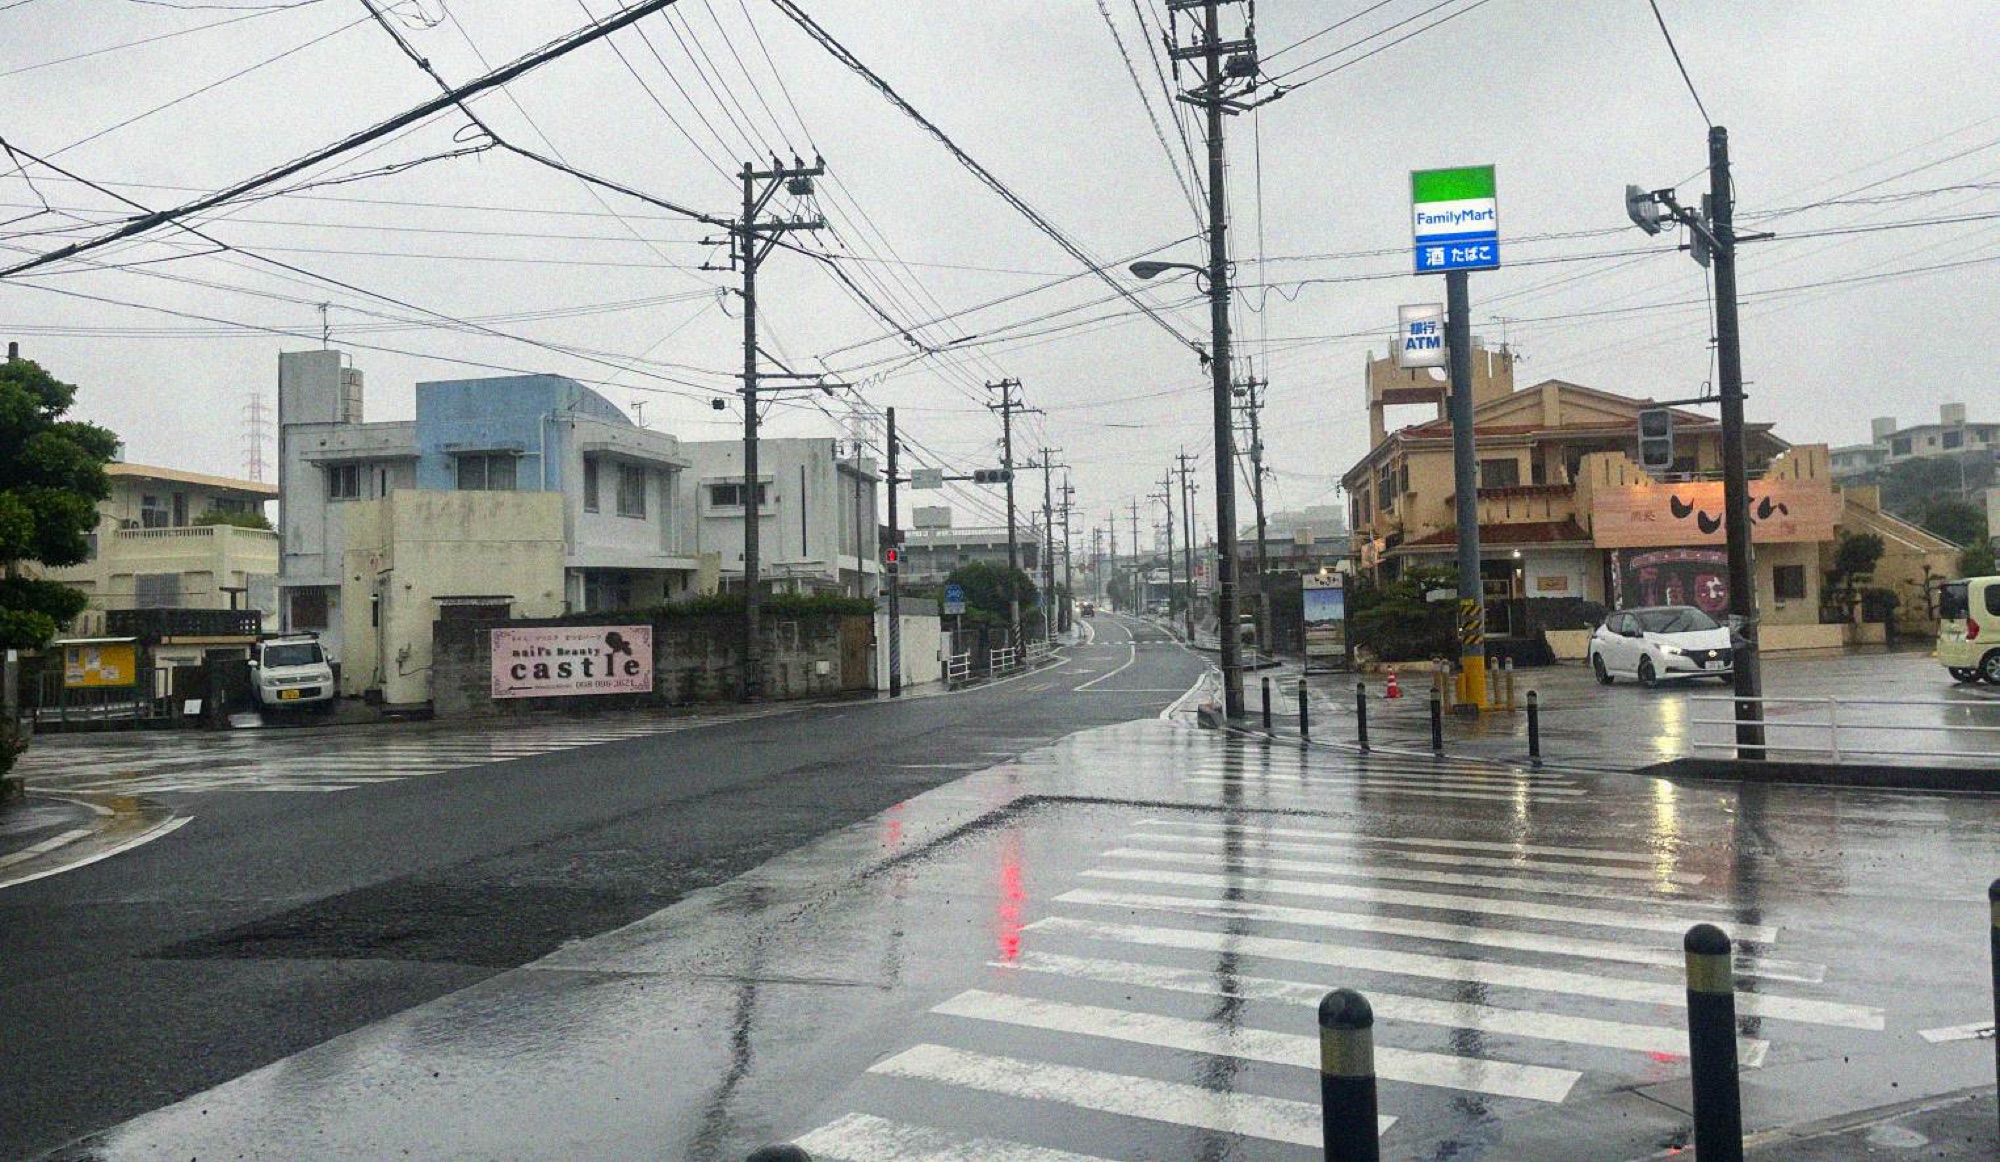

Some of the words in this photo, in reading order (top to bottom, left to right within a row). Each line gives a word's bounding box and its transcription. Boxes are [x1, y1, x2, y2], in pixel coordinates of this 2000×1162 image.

[1416, 208, 1494, 225] FamilyMart
[1425, 247, 1445, 266] 酒
[1451, 245, 1491, 262] たばこ
[1410, 320, 1437, 334] 銀行
[1405, 336, 1441, 350] ATM
[511, 652, 640, 680] castle
